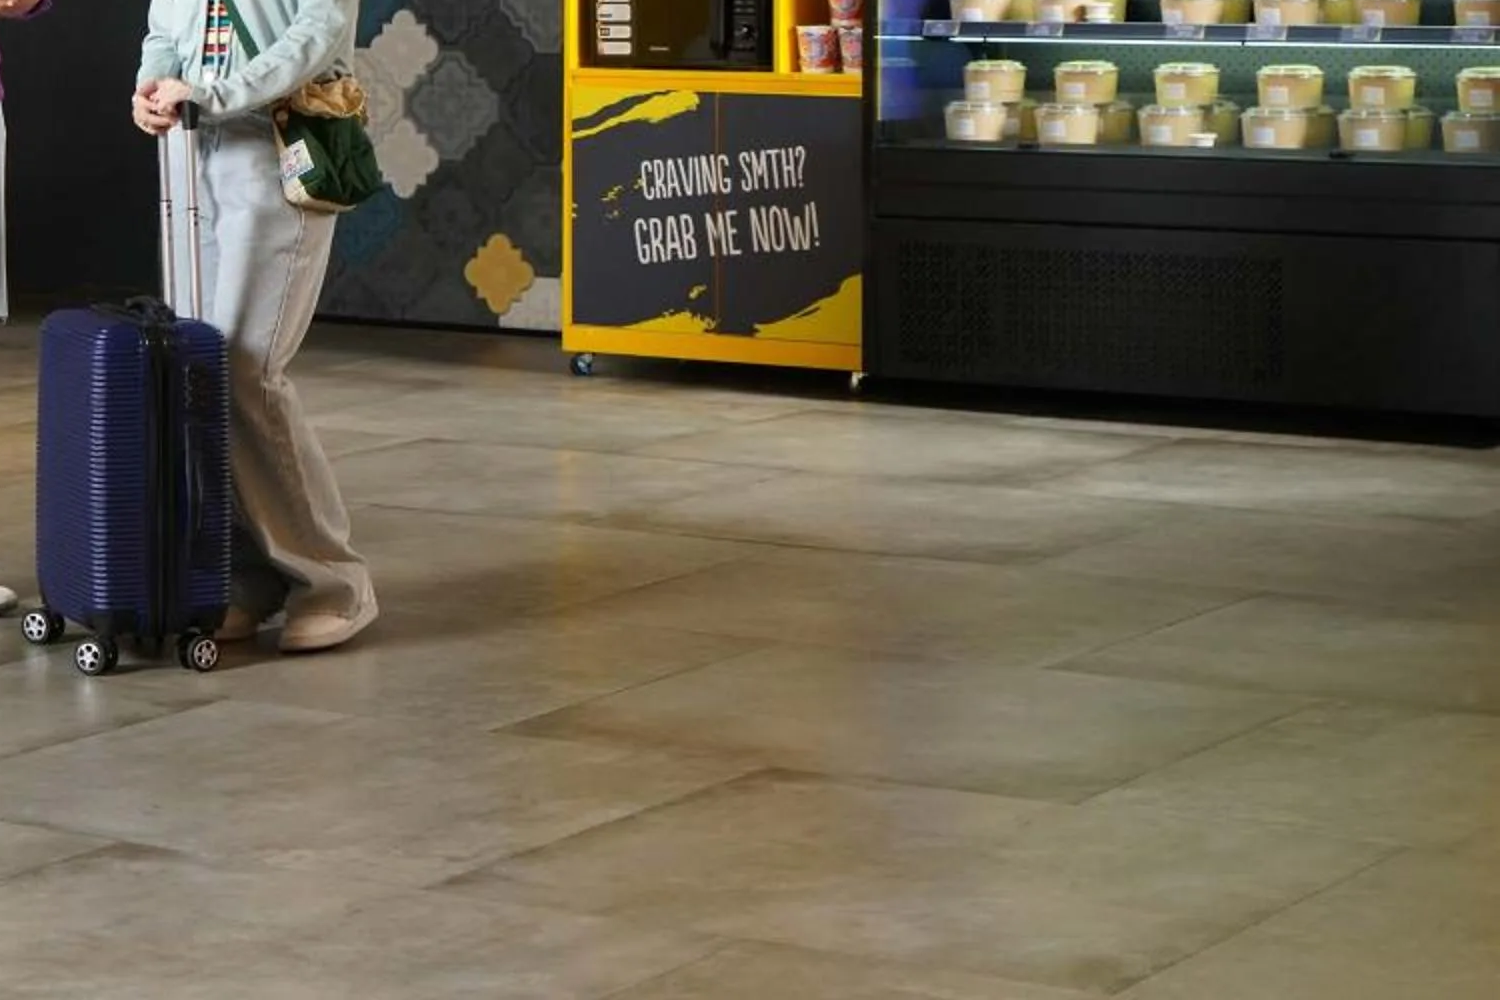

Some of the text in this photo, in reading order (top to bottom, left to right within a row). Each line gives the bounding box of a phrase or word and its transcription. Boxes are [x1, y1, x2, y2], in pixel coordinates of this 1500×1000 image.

[640, 145, 807, 201] CRAVING SMTH?
[634, 202, 821, 265] GRAB ME NOW!
